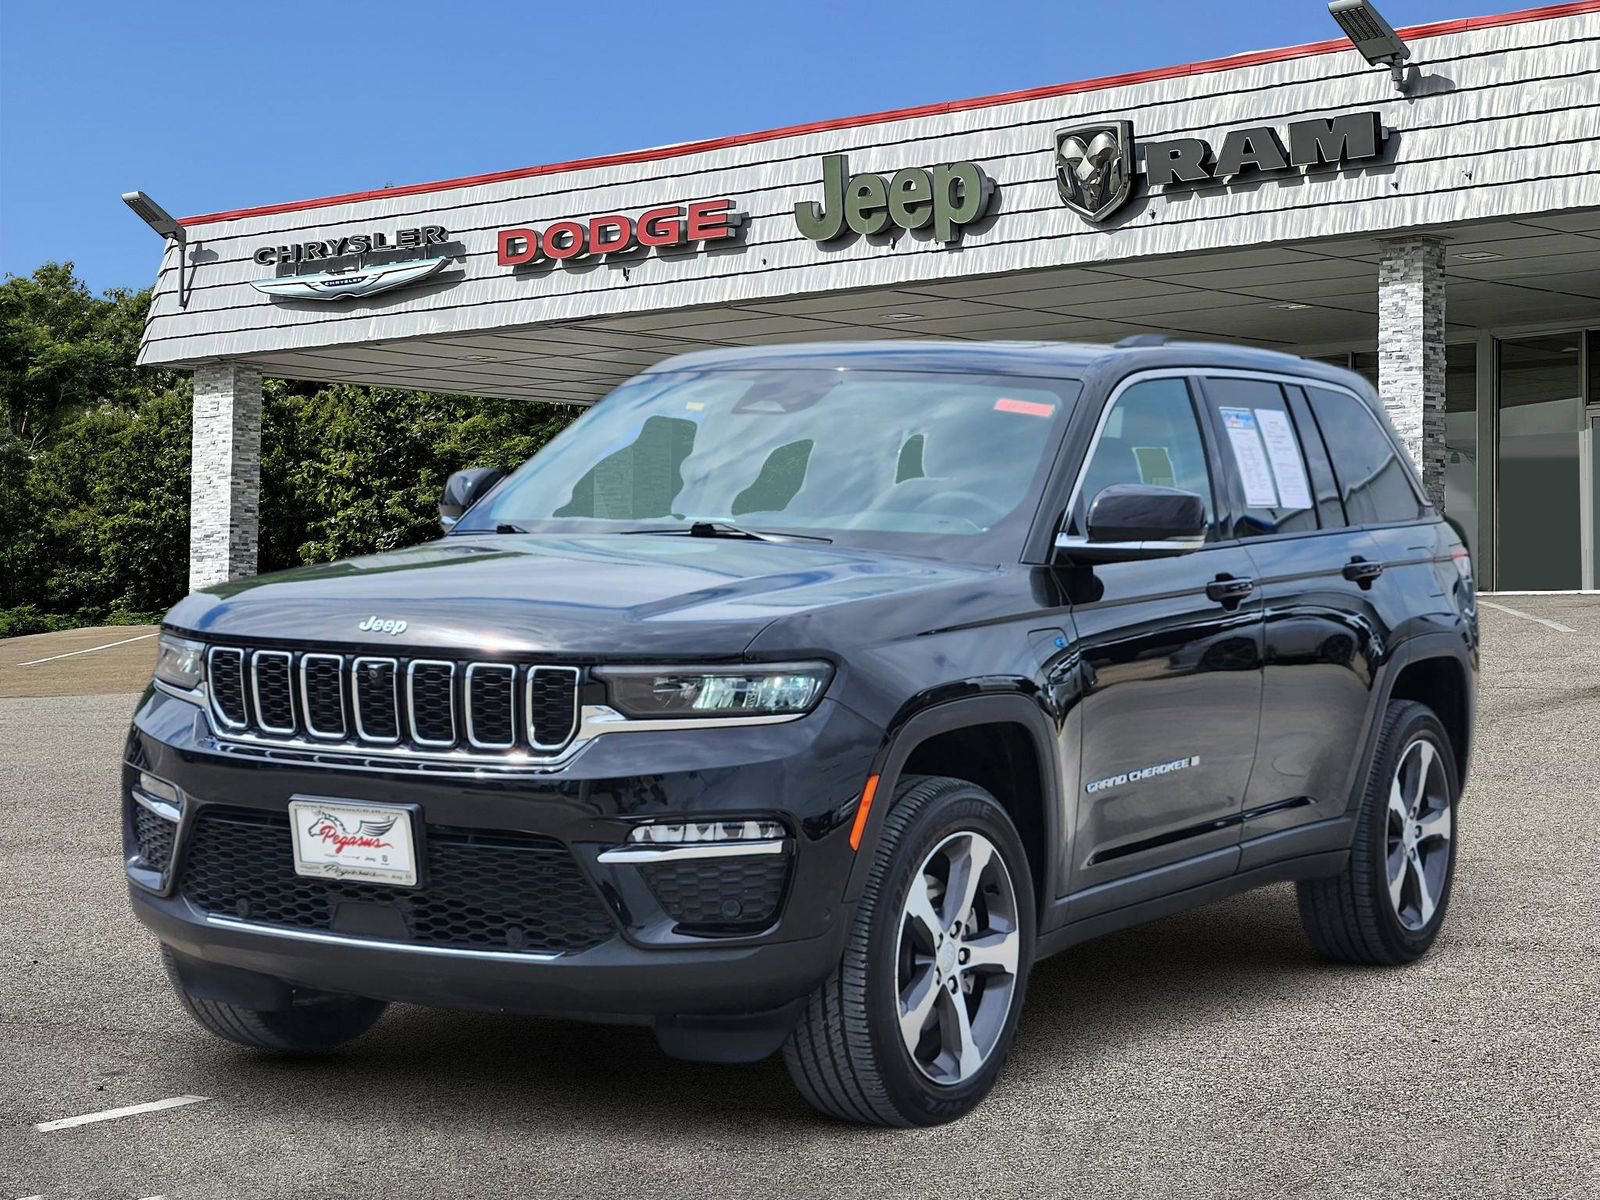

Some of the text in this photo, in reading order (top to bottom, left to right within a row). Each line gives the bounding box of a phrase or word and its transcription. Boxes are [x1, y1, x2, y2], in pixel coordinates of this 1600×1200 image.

[1145, 112, 1379, 186] RAM
[794, 154, 986, 241] Jeep
[253, 225, 448, 266] CHRYSLER
[497, 199, 734, 266] DODGE
[324, 276, 363, 286] CHRYSLER
[359, 616, 407, 636] Jeep
[1086, 758, 1190, 793] GRAND CHEROKEE
[319, 825, 394, 854] Pegasus
